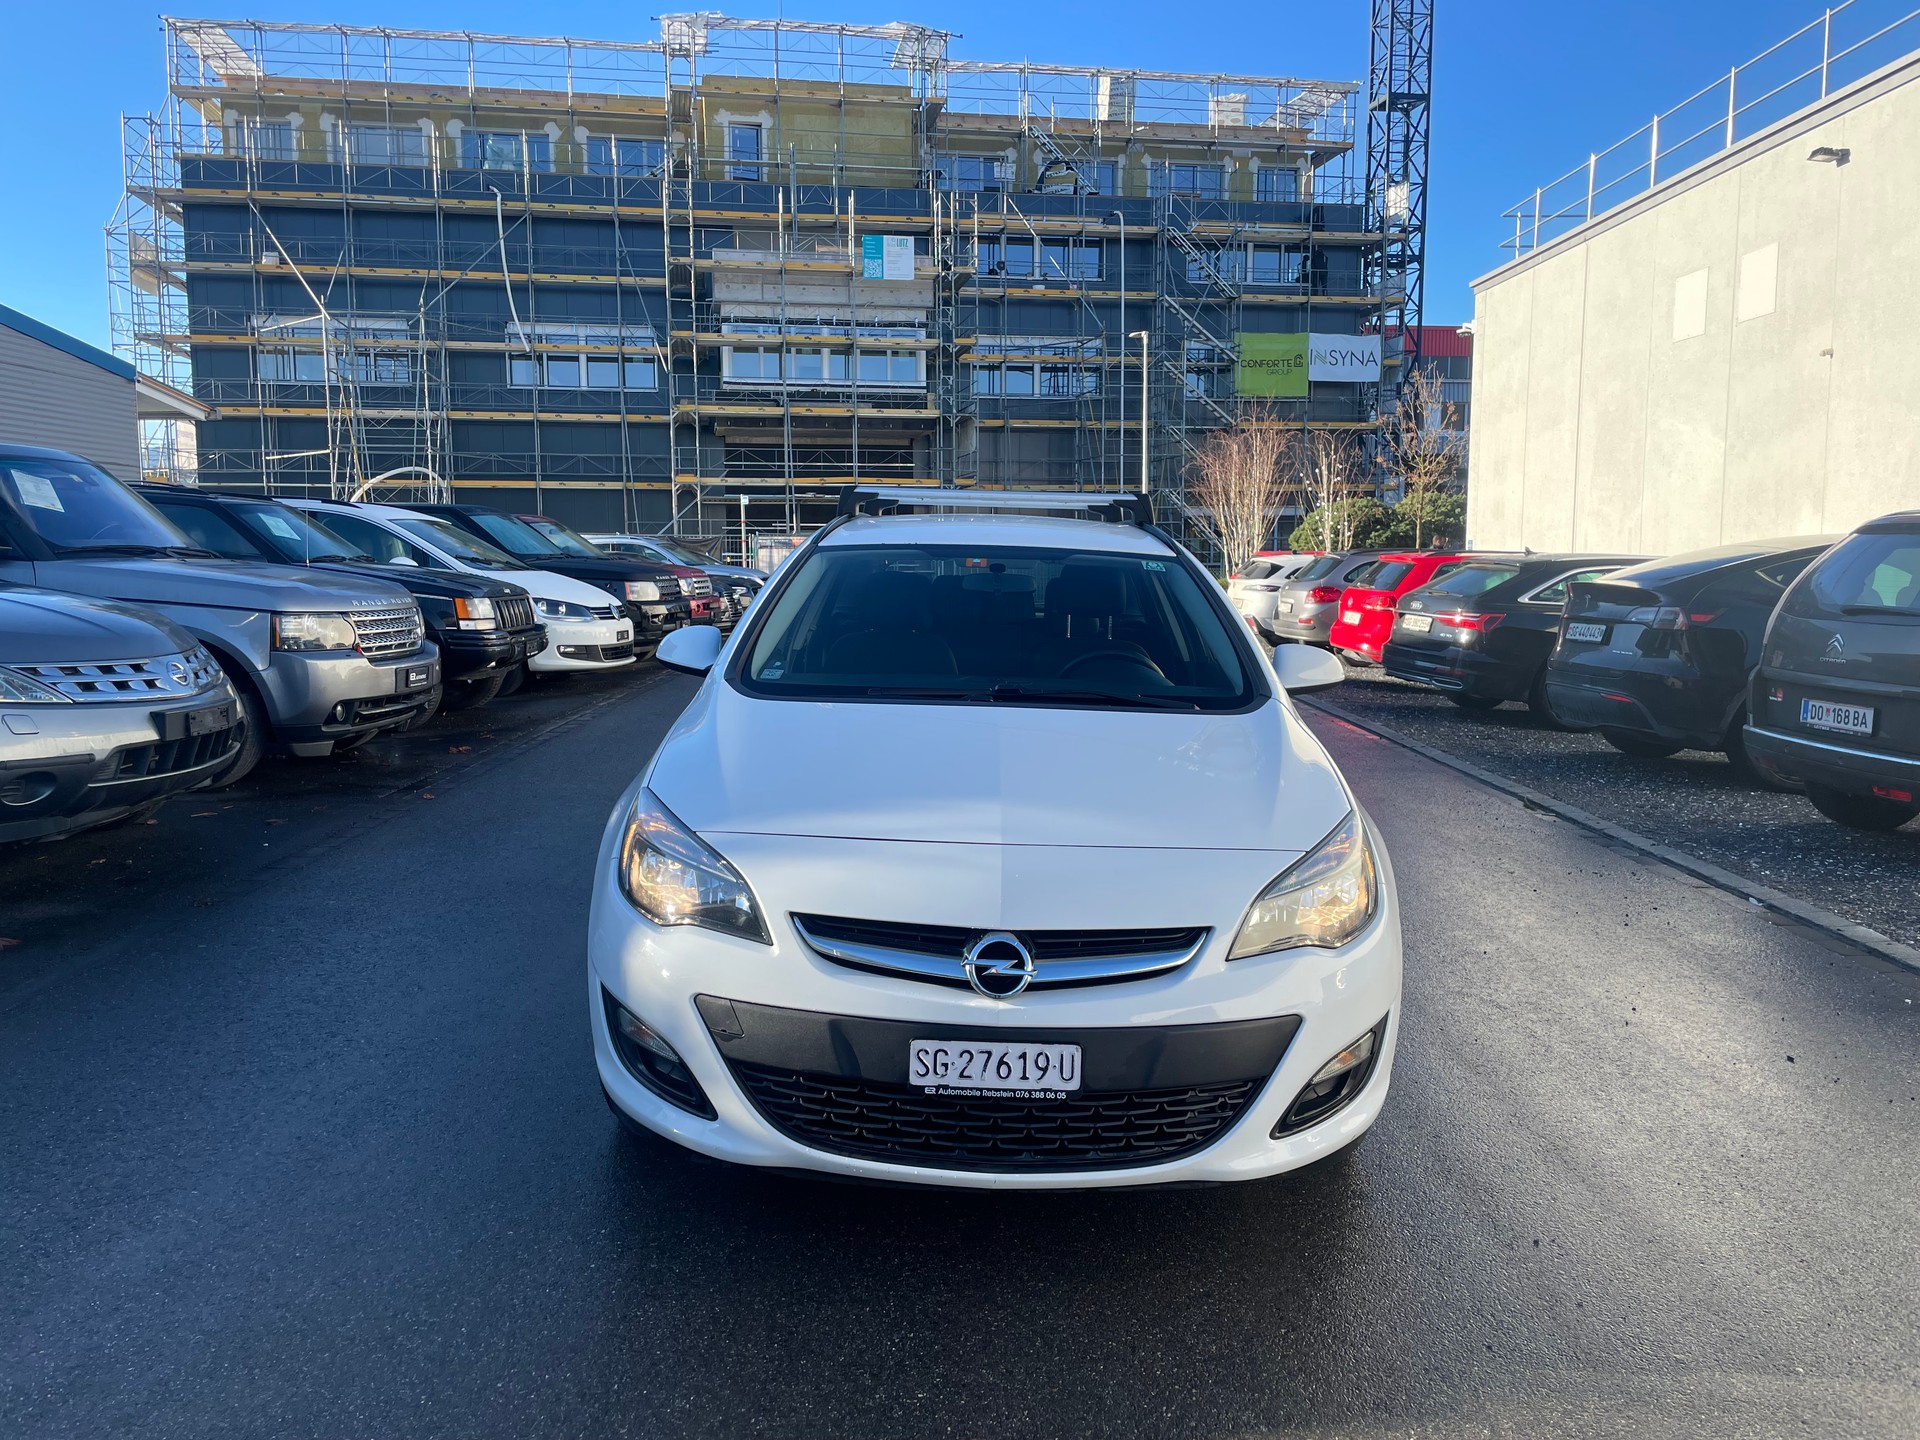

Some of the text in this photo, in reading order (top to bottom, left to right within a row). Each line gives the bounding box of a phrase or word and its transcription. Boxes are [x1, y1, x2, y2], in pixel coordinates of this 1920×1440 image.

[897, 238, 909, 247] LUTZ
[1310, 349, 1379, 367] INSYNA
[1831, 707, 1851, 726] 168
[1852, 710, 1868, 729] BA
[938, 1087, 981, 1097] Automobile
[982, 1090, 1014, 1098] Rebstein
[1031, 1091, 1045, 1099] 388
